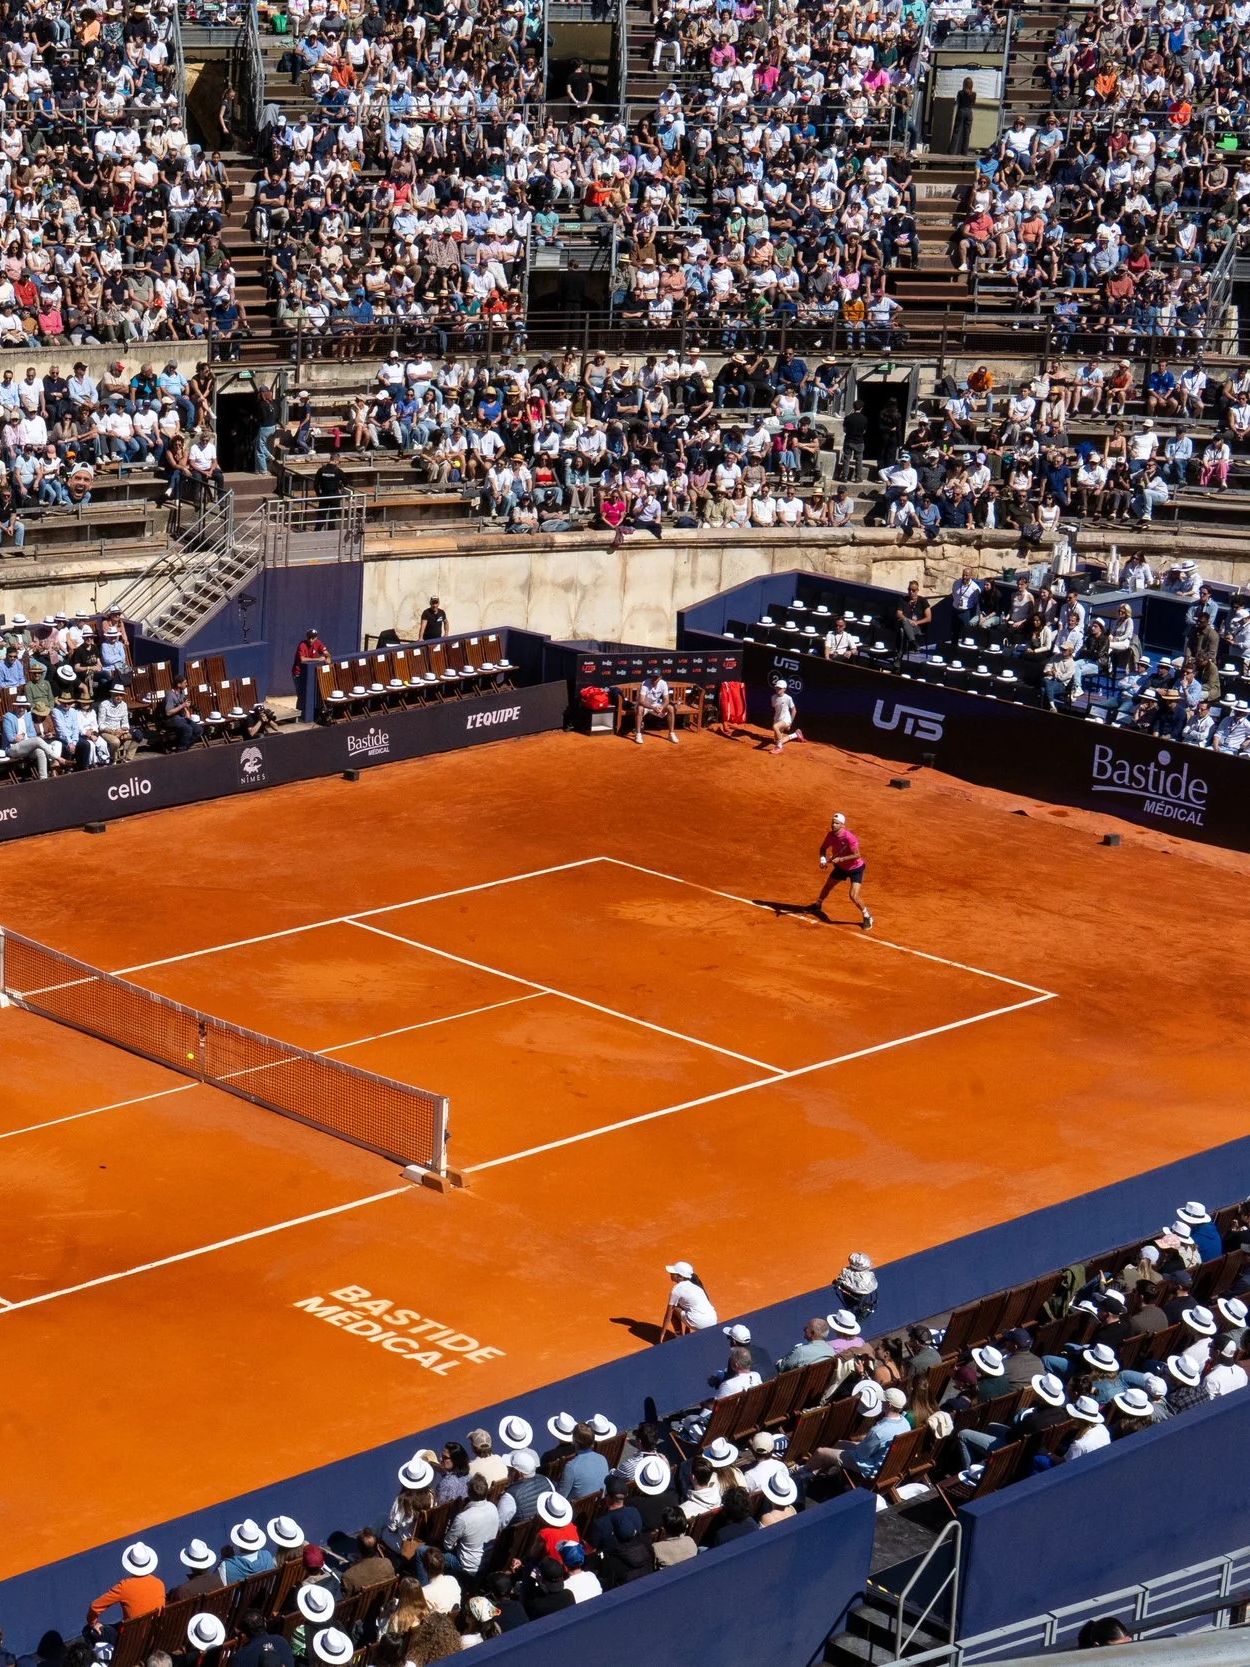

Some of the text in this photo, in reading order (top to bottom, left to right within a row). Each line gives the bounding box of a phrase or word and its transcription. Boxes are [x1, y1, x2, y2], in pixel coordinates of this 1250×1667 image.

[774, 655, 800, 671] UTS
[788, 679, 802, 690] 20
[466, 705, 522, 730] L'ÉQUIPE
[872, 699, 946, 742] UTS
[347, 727, 389, 751] Bastide
[1092, 744, 1208, 805] Bastide
[107, 776, 152, 801] celio
[1143, 799, 1204, 826] MÉDICAL
[292, 1296, 461, 1376] MÉDICAL
[328, 1284, 507, 1365] BASTIDE
